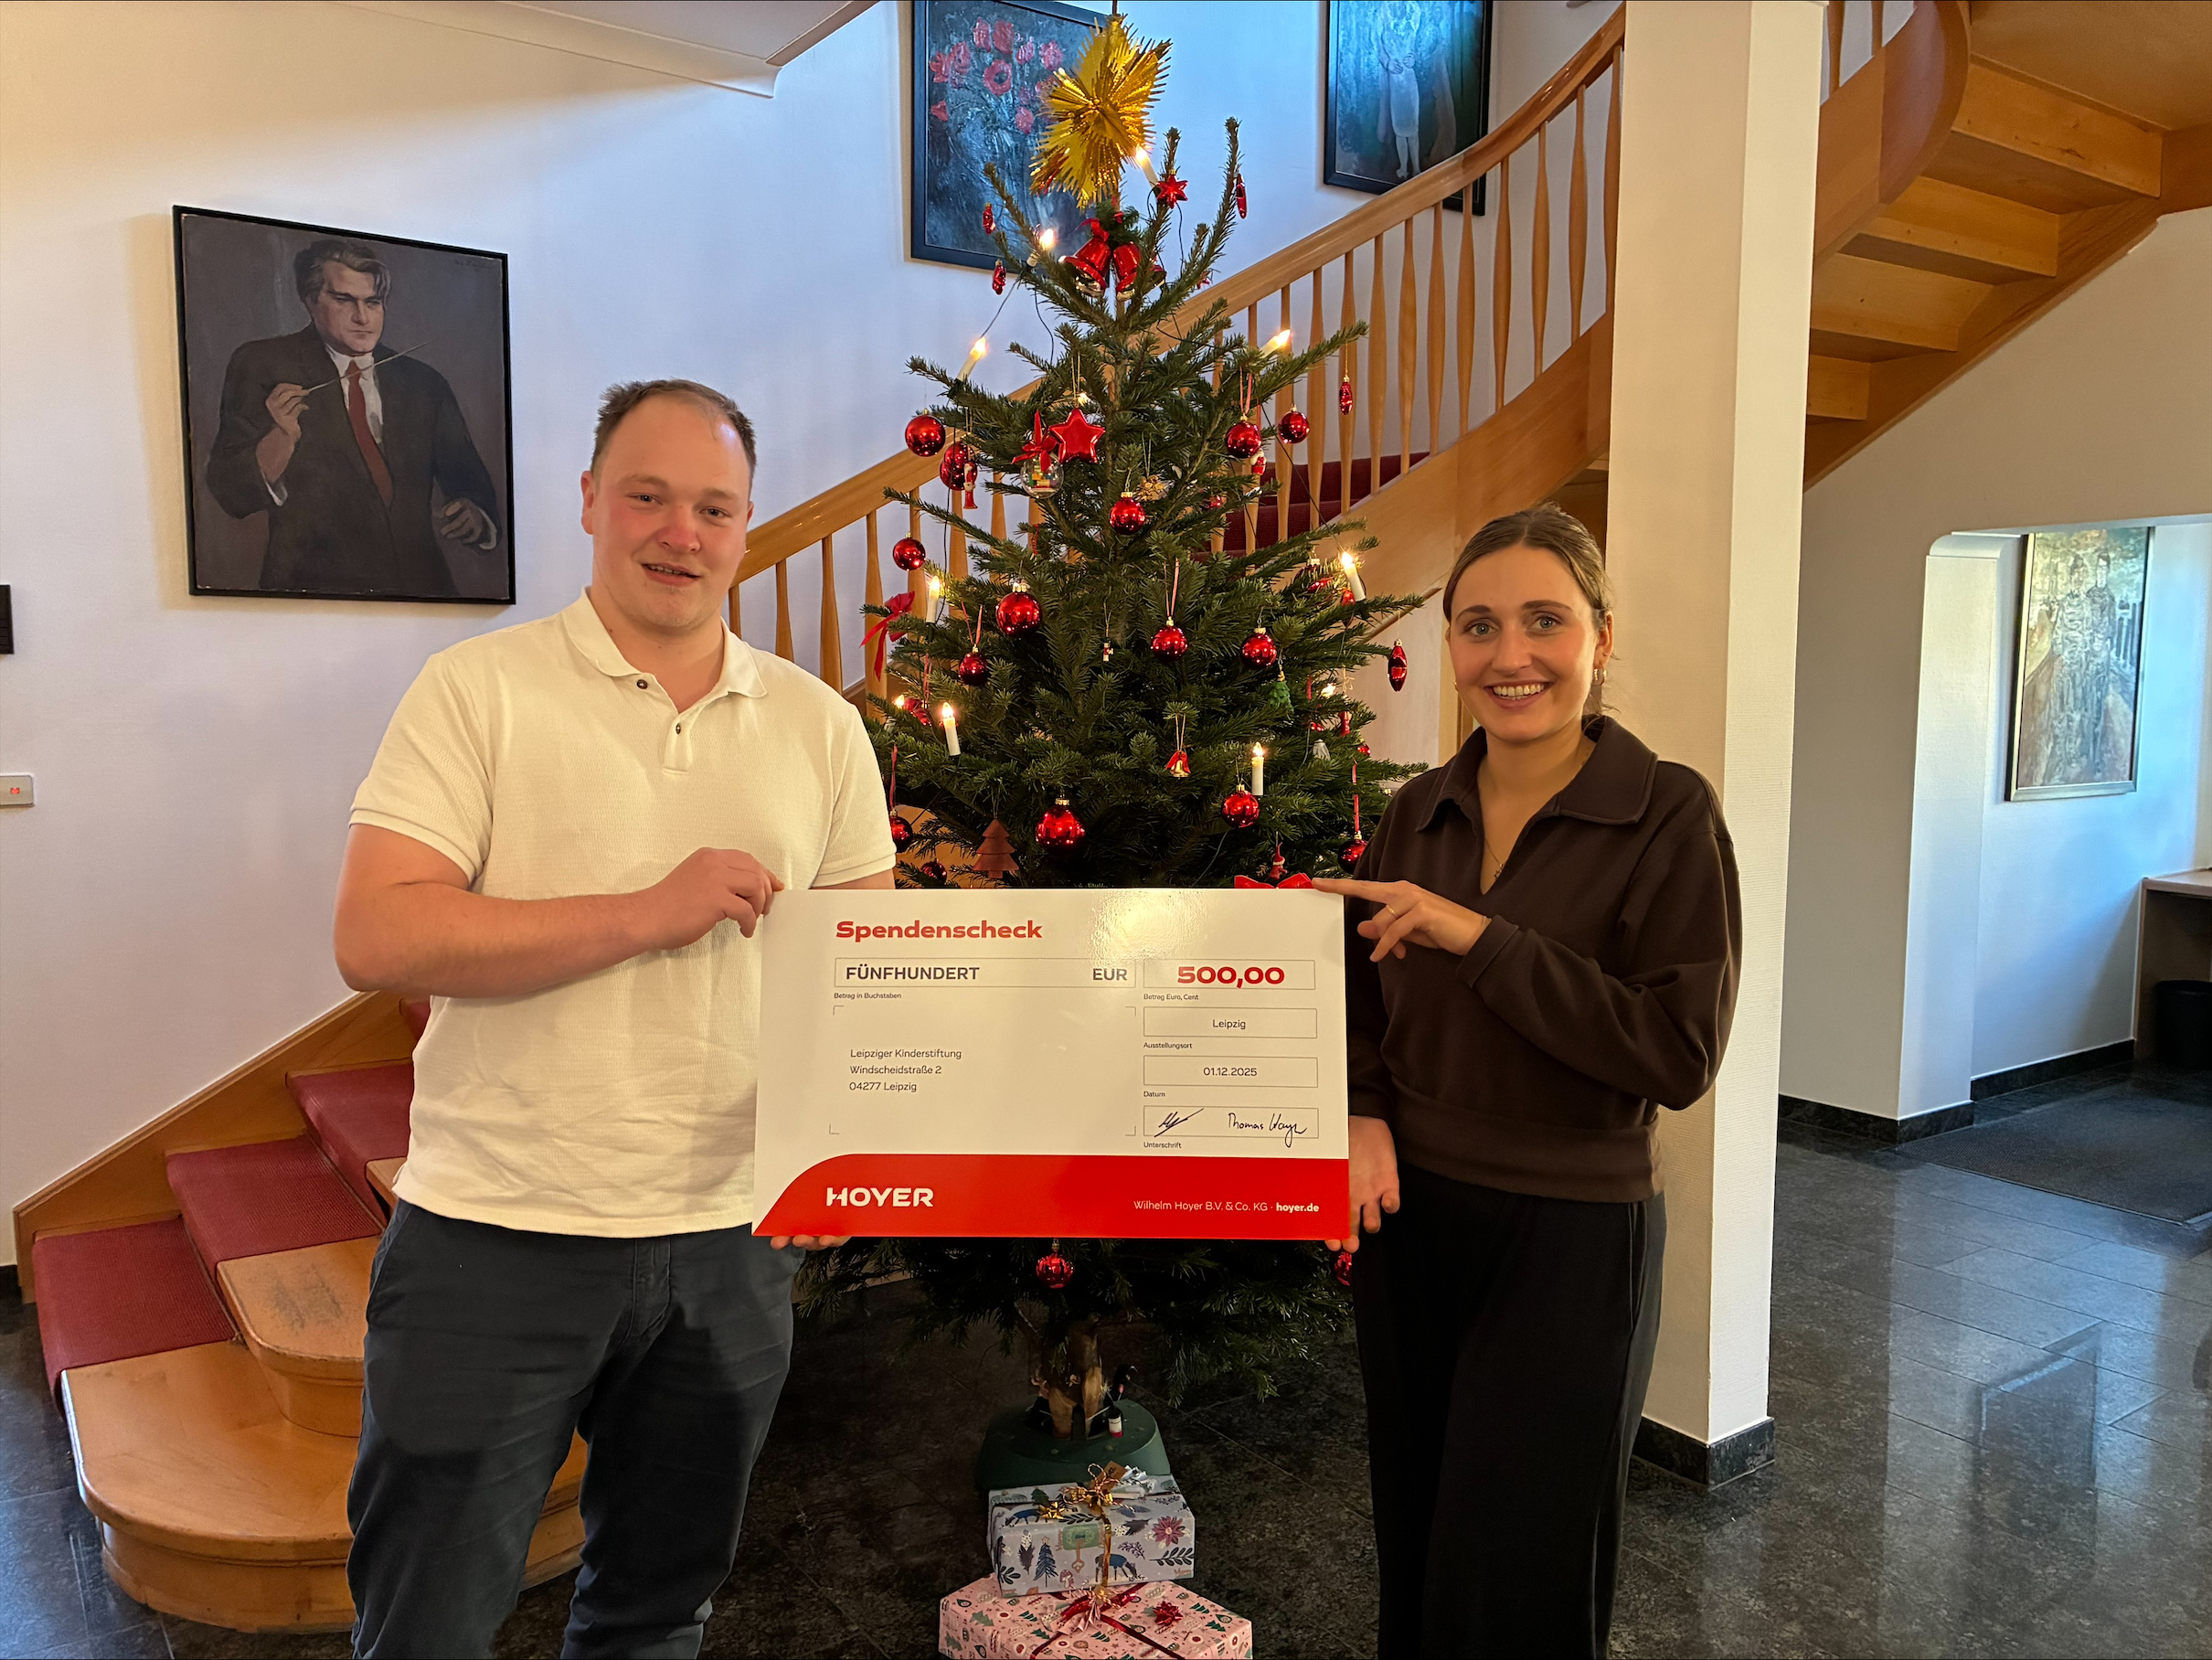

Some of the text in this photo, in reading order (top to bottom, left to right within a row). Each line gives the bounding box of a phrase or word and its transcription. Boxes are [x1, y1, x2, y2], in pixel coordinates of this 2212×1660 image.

[836, 920, 1043, 942] Spendenscheck
[845, 963, 1128, 981] FÜNFHUNDERT EUR
[1177, 966, 1285, 988] 500,00
[1212, 1019, 1247, 1030] Leipzig
[850, 1048, 962, 1060] Leipziger Kinderstiftung
[849, 1065, 942, 1075] Windscheidstraße 2
[1203, 1067, 1258, 1077] 01.12.2025
[848, 1081, 918, 1093] 04277 Leipzig
[1228, 1112, 1264, 1131] Thomas
[1143, 1141, 1182, 1149] Unterschrift
[826, 1187, 934, 1208] HOYER
[1133, 1200, 1320, 1214] Wilhelm Hoyer B.V. & Co. KG hoyer.de
